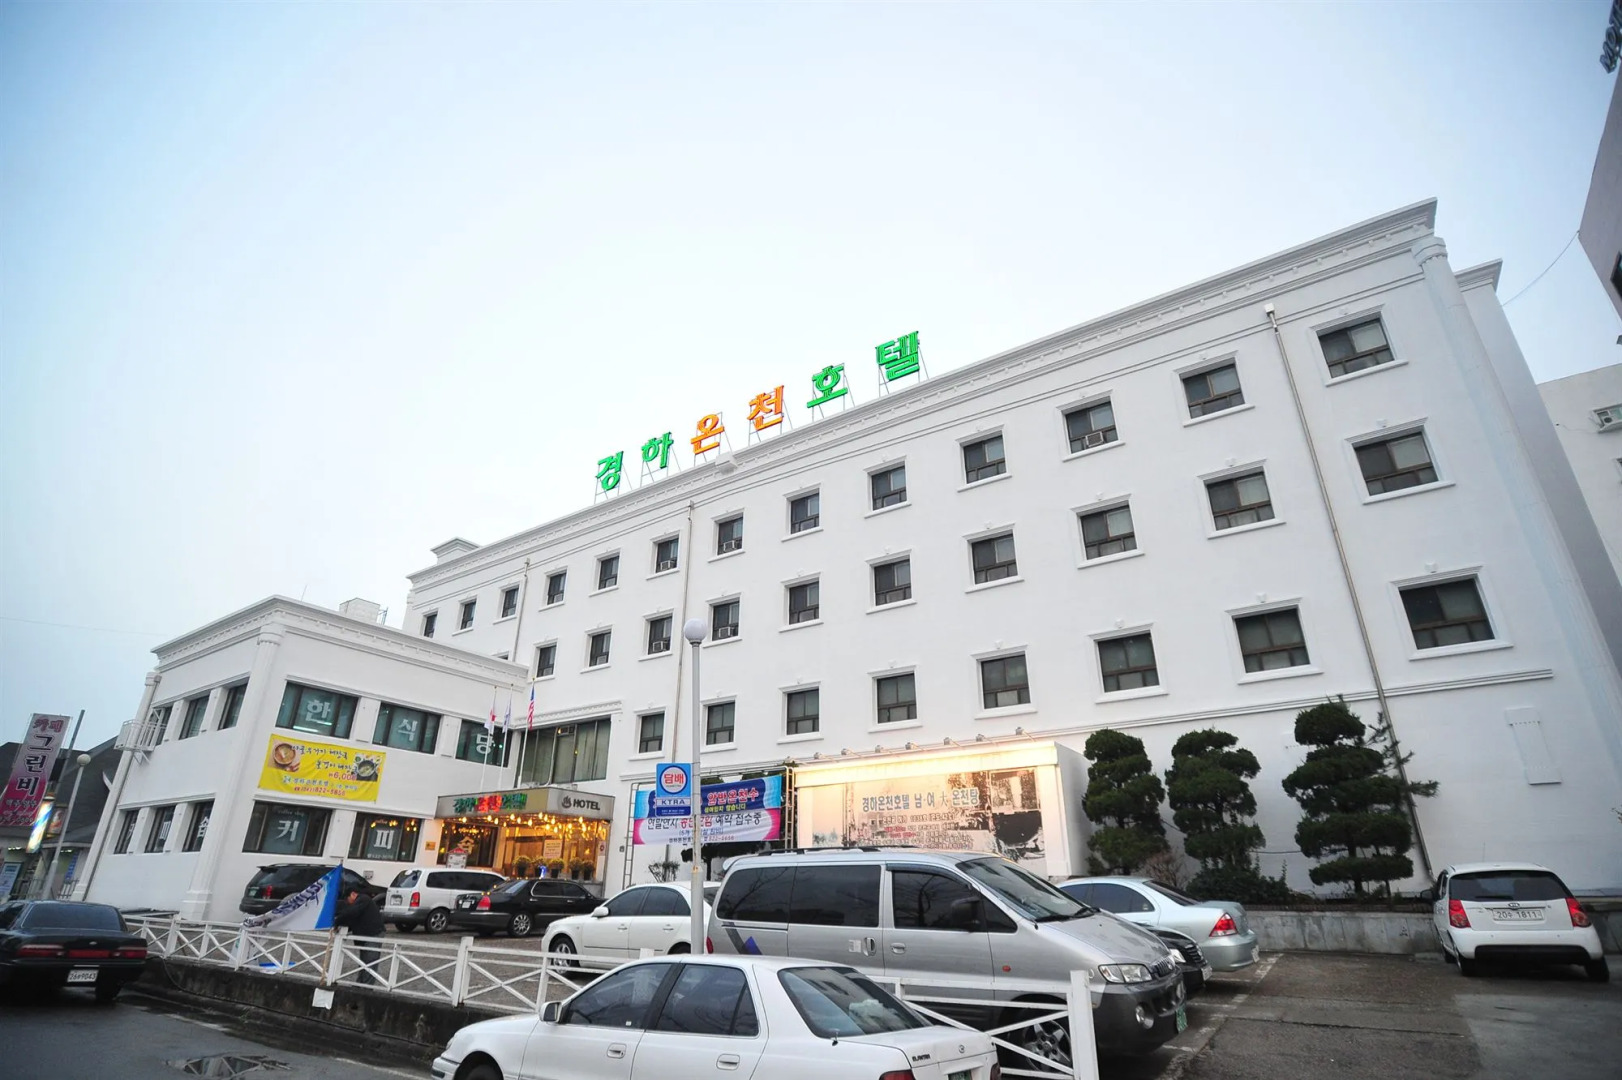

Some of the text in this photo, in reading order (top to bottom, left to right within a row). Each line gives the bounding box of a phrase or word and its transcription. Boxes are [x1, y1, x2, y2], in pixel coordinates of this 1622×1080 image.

[32, 718, 64, 732] 카페
[663, 773, 684, 785] 담배
[707, 787, 759, 806] 암반온천수
[862, 794, 910, 812] 경하온천호텔
[952, 788, 979, 806] 온천탕
[573, 799, 600, 811] HOTEL
[647, 817, 678, 830] 연말연시
[715, 814, 733, 827] 예약
[735, 813, 762, 826] 접수중
